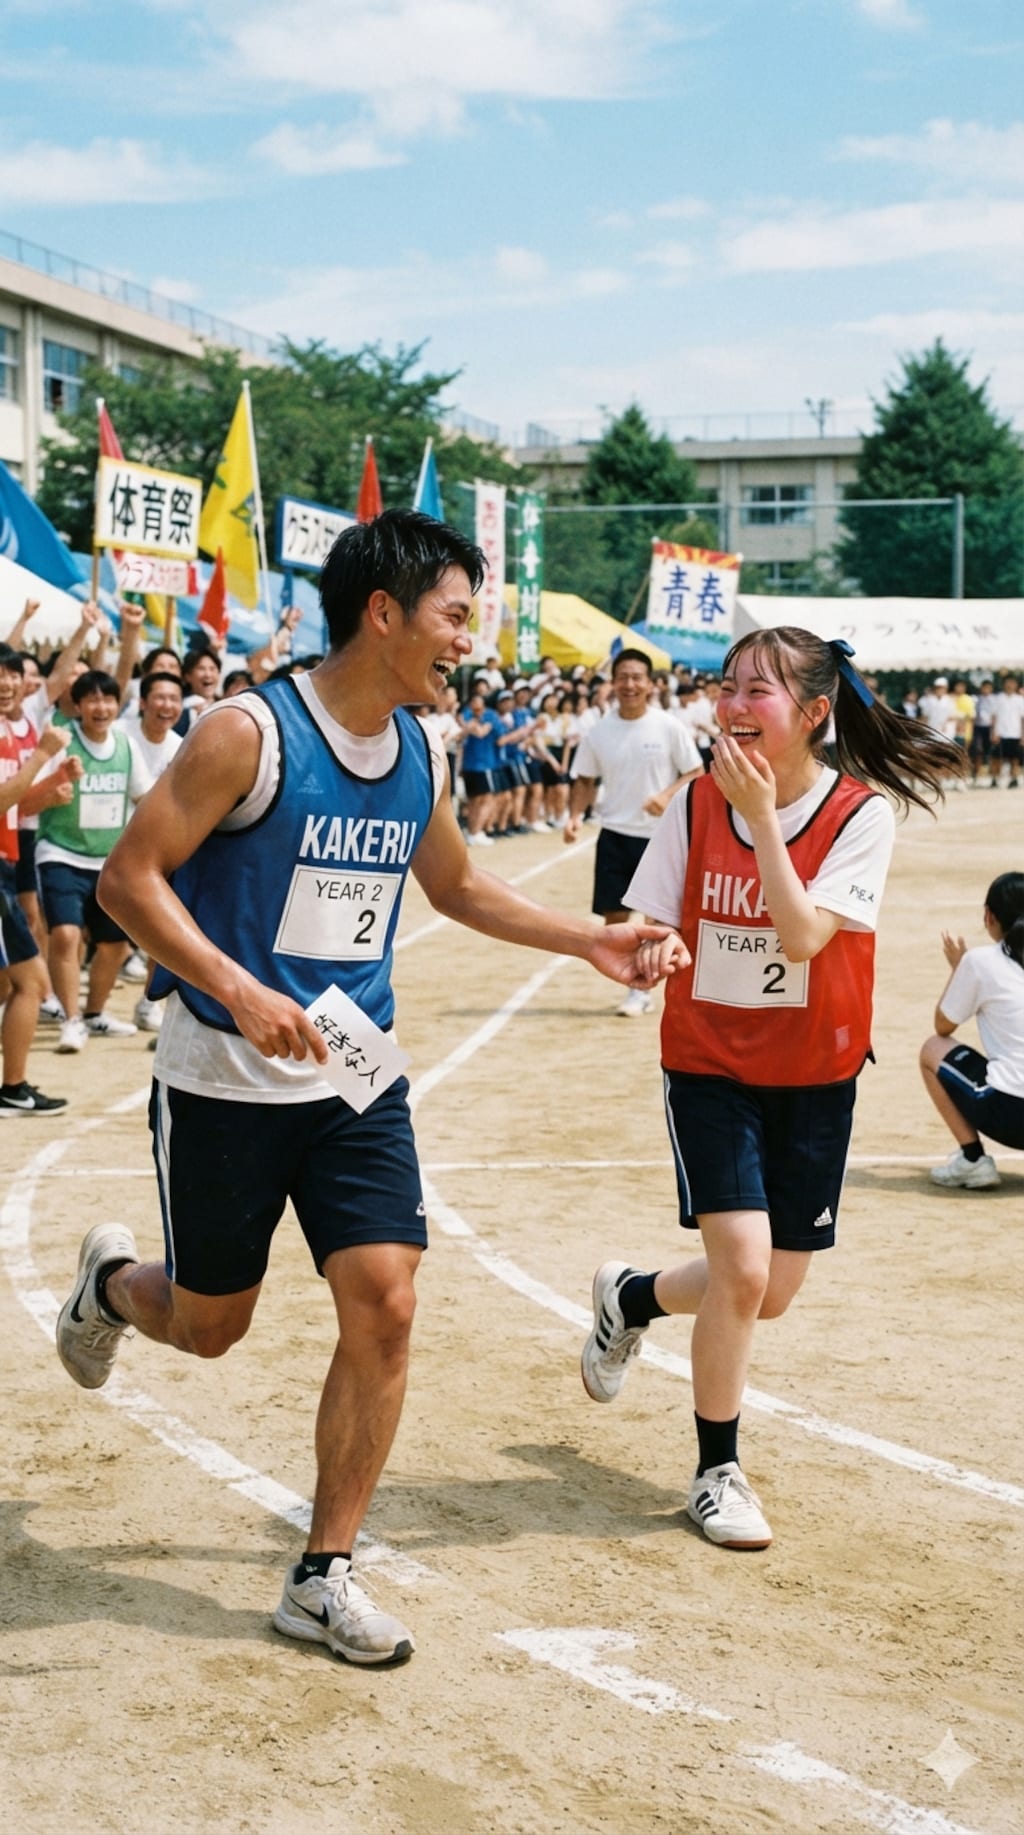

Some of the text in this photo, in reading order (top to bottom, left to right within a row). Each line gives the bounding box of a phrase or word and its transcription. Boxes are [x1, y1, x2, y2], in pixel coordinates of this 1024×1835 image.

[110, 472, 193, 545] 体育祭
[662, 565, 726, 623] 青春
[299, 814, 417, 865] KAKERU
[316, 879, 383, 901] YEAR 2
[702, 871, 769, 918] HIKA
[353, 909, 376, 944] 2
[716, 931, 767, 953] YEAR
[762, 963, 786, 994] 2
[313, 1013, 381, 1088] 好きな人
